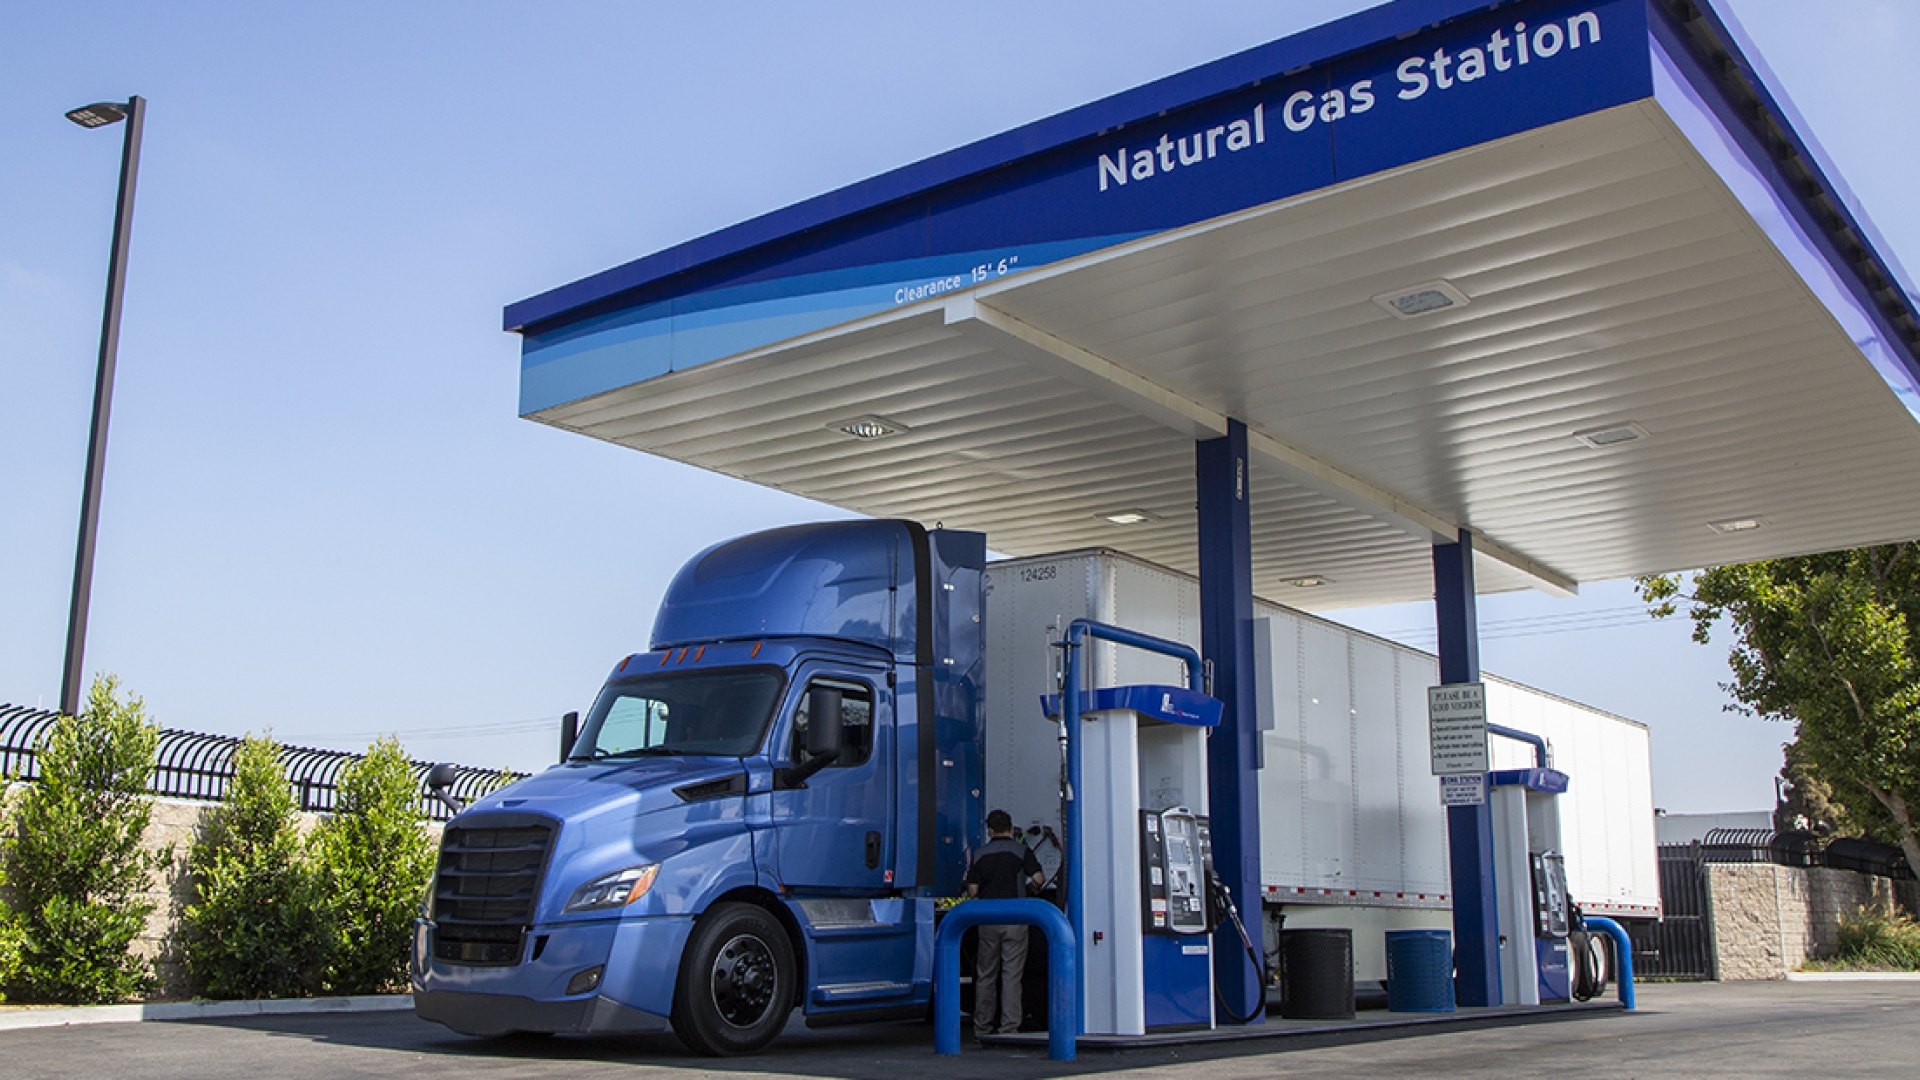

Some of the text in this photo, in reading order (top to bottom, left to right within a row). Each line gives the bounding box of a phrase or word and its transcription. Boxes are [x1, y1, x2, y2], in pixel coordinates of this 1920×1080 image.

[1098, 10, 1601, 191] Natural Gas Station
[895, 275, 961, 304] Clearance
[971, 263, 992, 282] 15'
[1020, 566, 1056, 582] 124258
